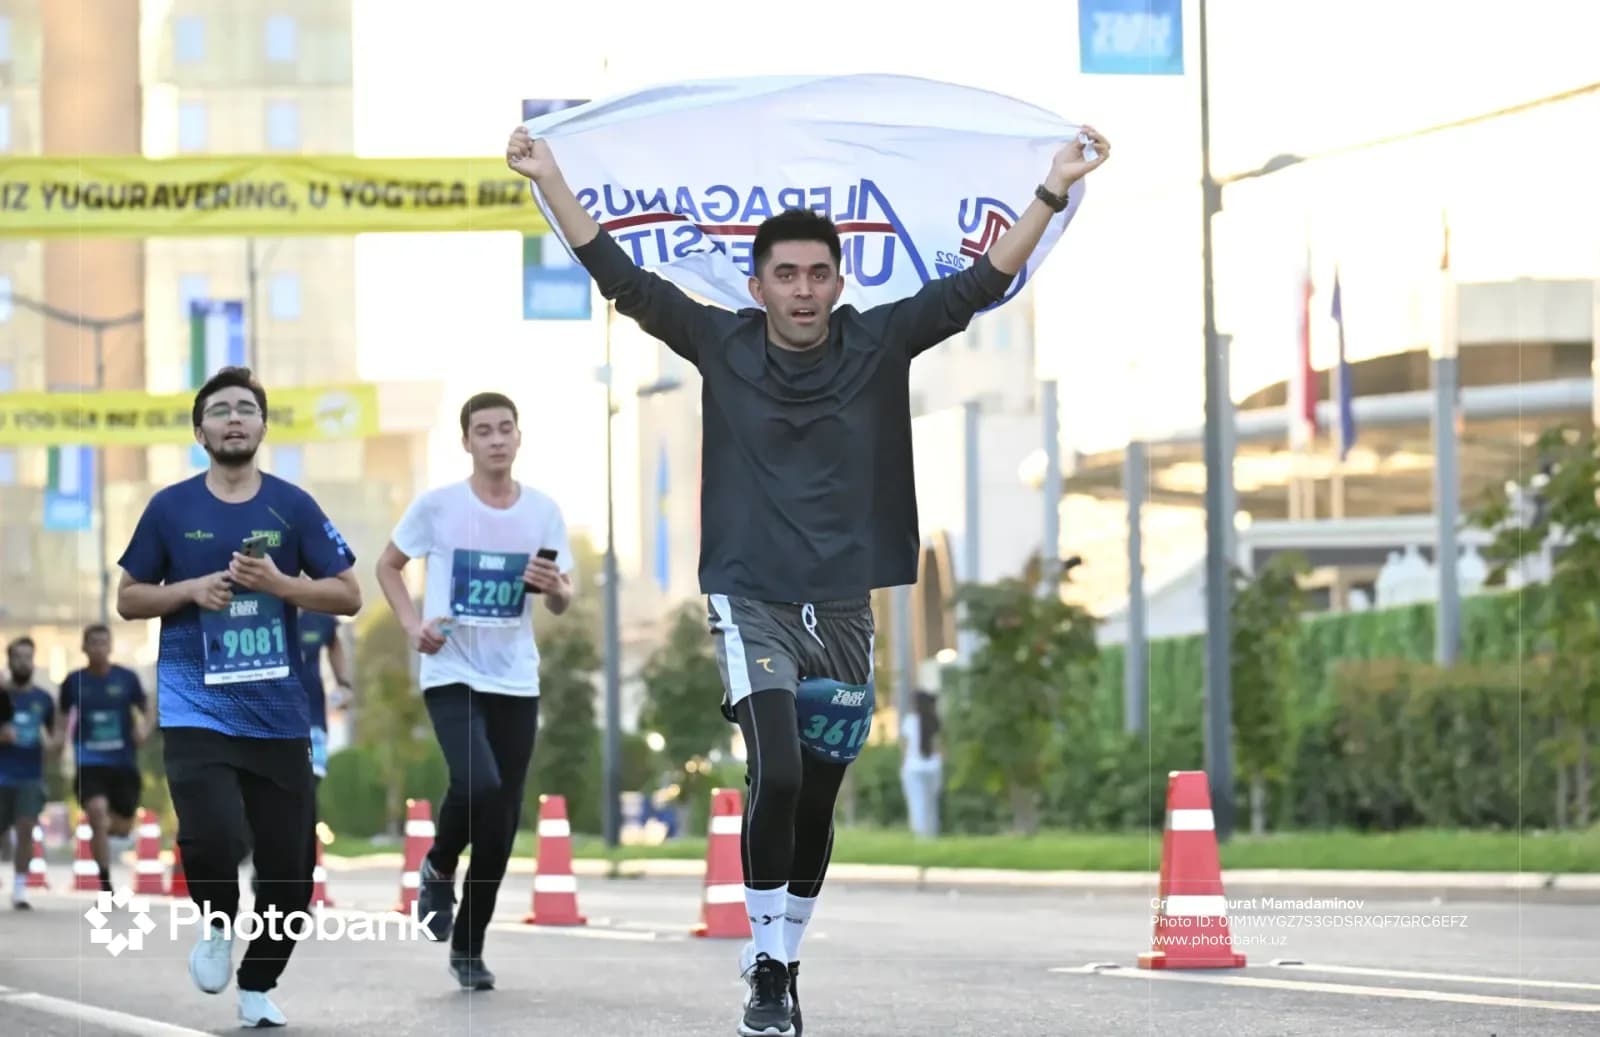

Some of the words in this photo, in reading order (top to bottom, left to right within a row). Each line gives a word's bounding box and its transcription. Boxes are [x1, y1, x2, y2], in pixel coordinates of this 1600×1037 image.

[308, 179, 330, 209] U
[477, 179, 526, 208] BIZ
[468, 579, 525, 607] 2207
[223, 625, 285, 659] 9081
[835, 688, 866, 699] TASH
